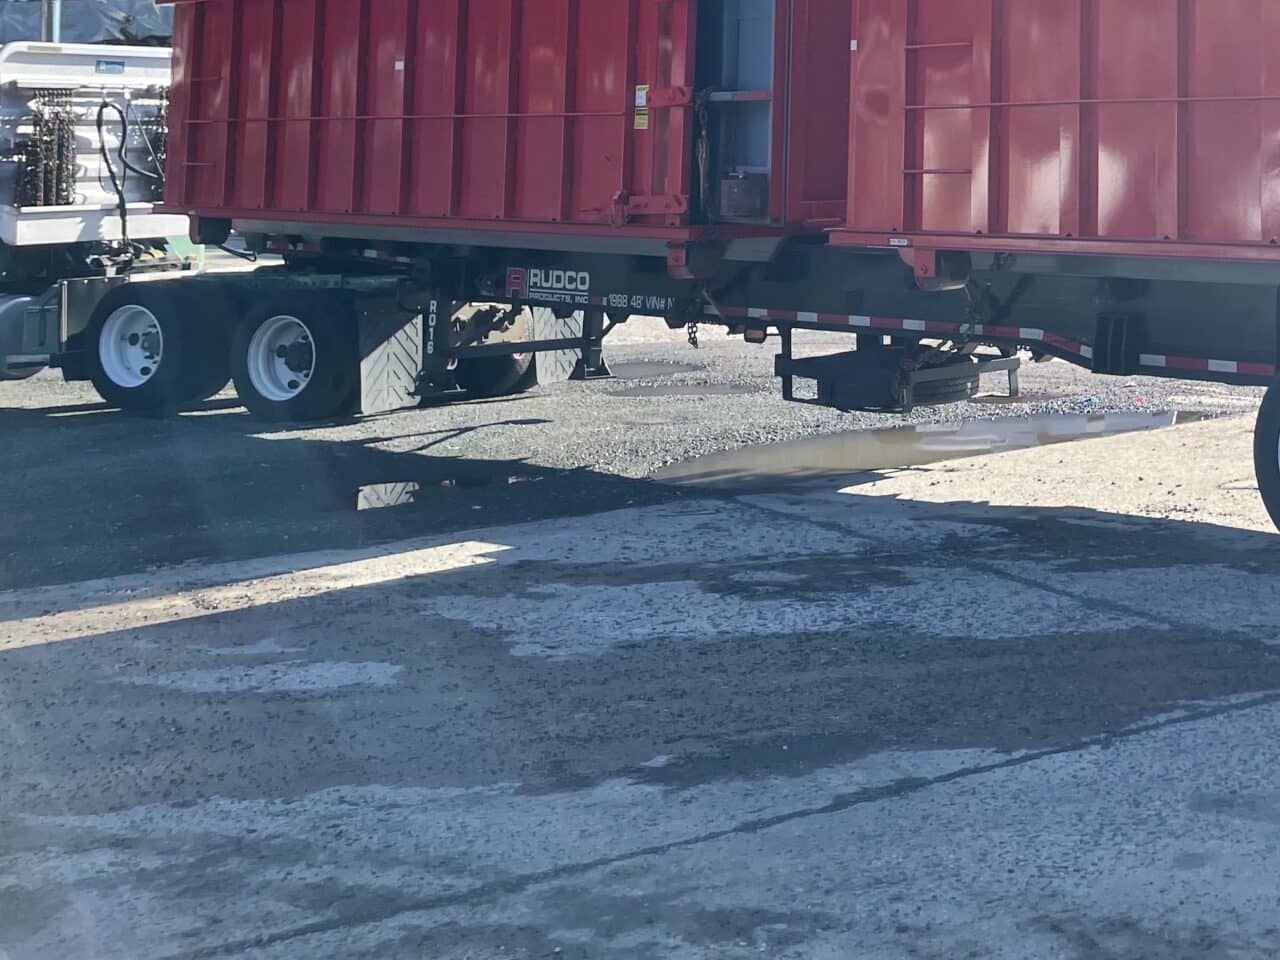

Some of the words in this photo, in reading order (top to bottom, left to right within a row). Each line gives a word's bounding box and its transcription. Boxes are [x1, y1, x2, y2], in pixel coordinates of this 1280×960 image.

[529, 269, 590, 290] RUDCO
[529, 292, 573, 304] PRODUCTS,
[645, 296, 666, 310] VIN#
